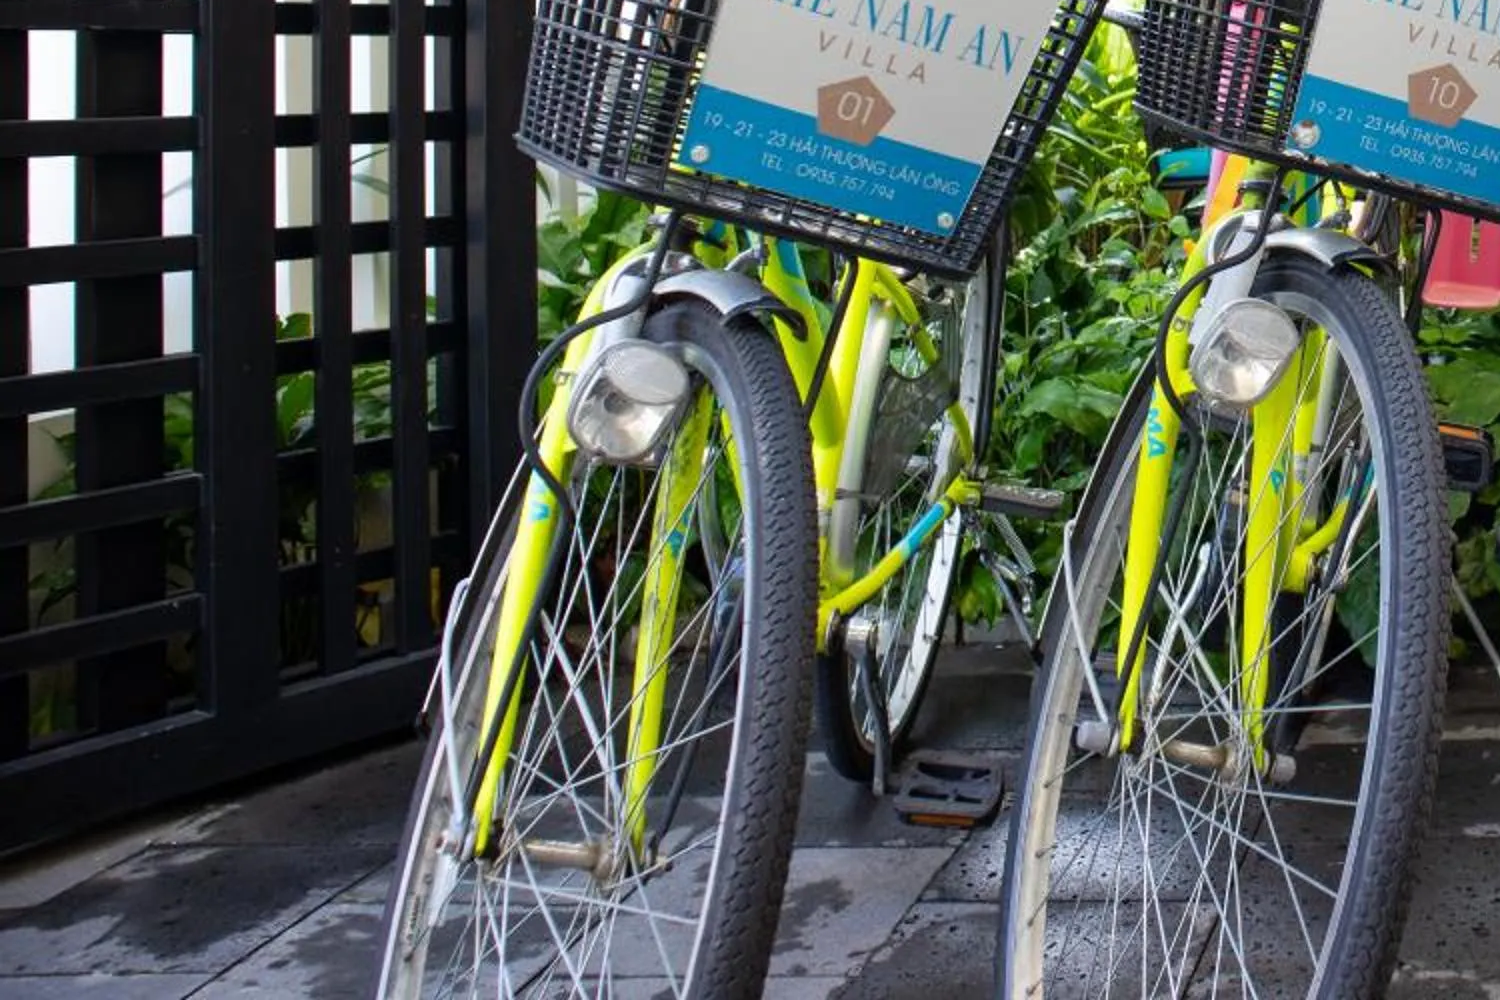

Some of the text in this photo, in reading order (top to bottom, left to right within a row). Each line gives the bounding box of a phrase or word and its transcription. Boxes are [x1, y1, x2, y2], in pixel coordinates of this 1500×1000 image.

[818, 30, 926, 85] VILLA
[956, 25, 1025, 76] AN
[836, 91, 875, 127] 01
[1427, 75, 1460, 109] 10
[703, 111, 722, 128] 19
[733, 120, 753, 137] 21
[766, 130, 787, 148] 23
[1308, 98, 1327, 115] 19
[1336, 106, 1353, 122] 21
[1363, 114, 1382, 131] 23
